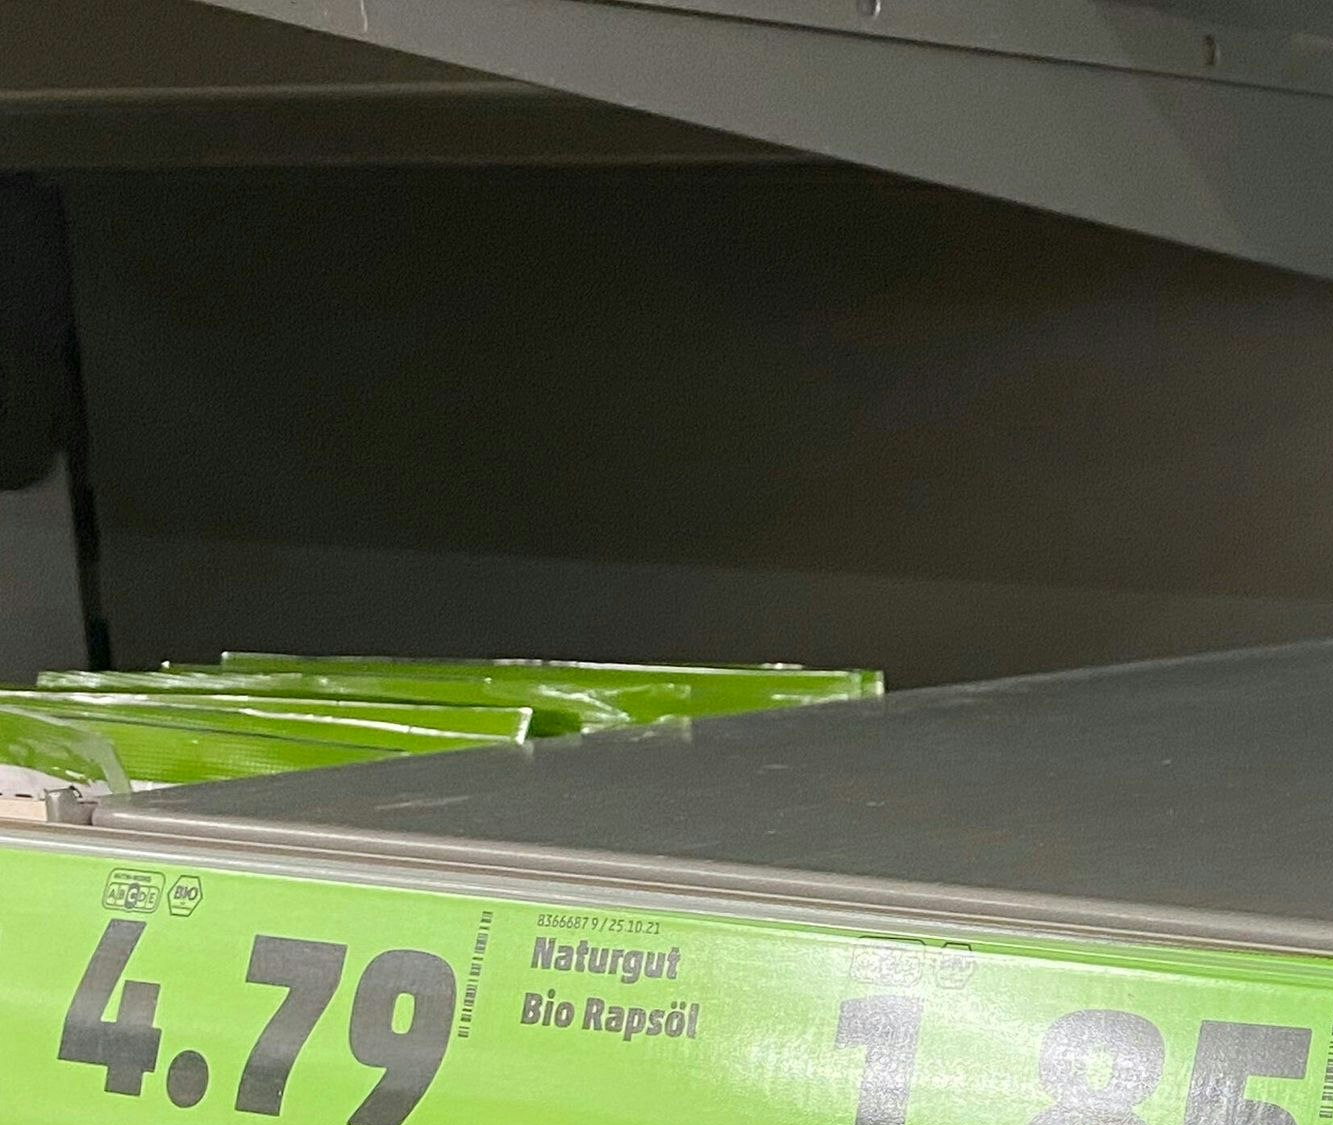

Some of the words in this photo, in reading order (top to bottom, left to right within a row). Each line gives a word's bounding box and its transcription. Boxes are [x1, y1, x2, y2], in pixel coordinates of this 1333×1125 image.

[531, 936, 681, 984] Naturgut
[521, 988, 575, 1028] Bio
[582, 997, 700, 1042] Rapsöl
